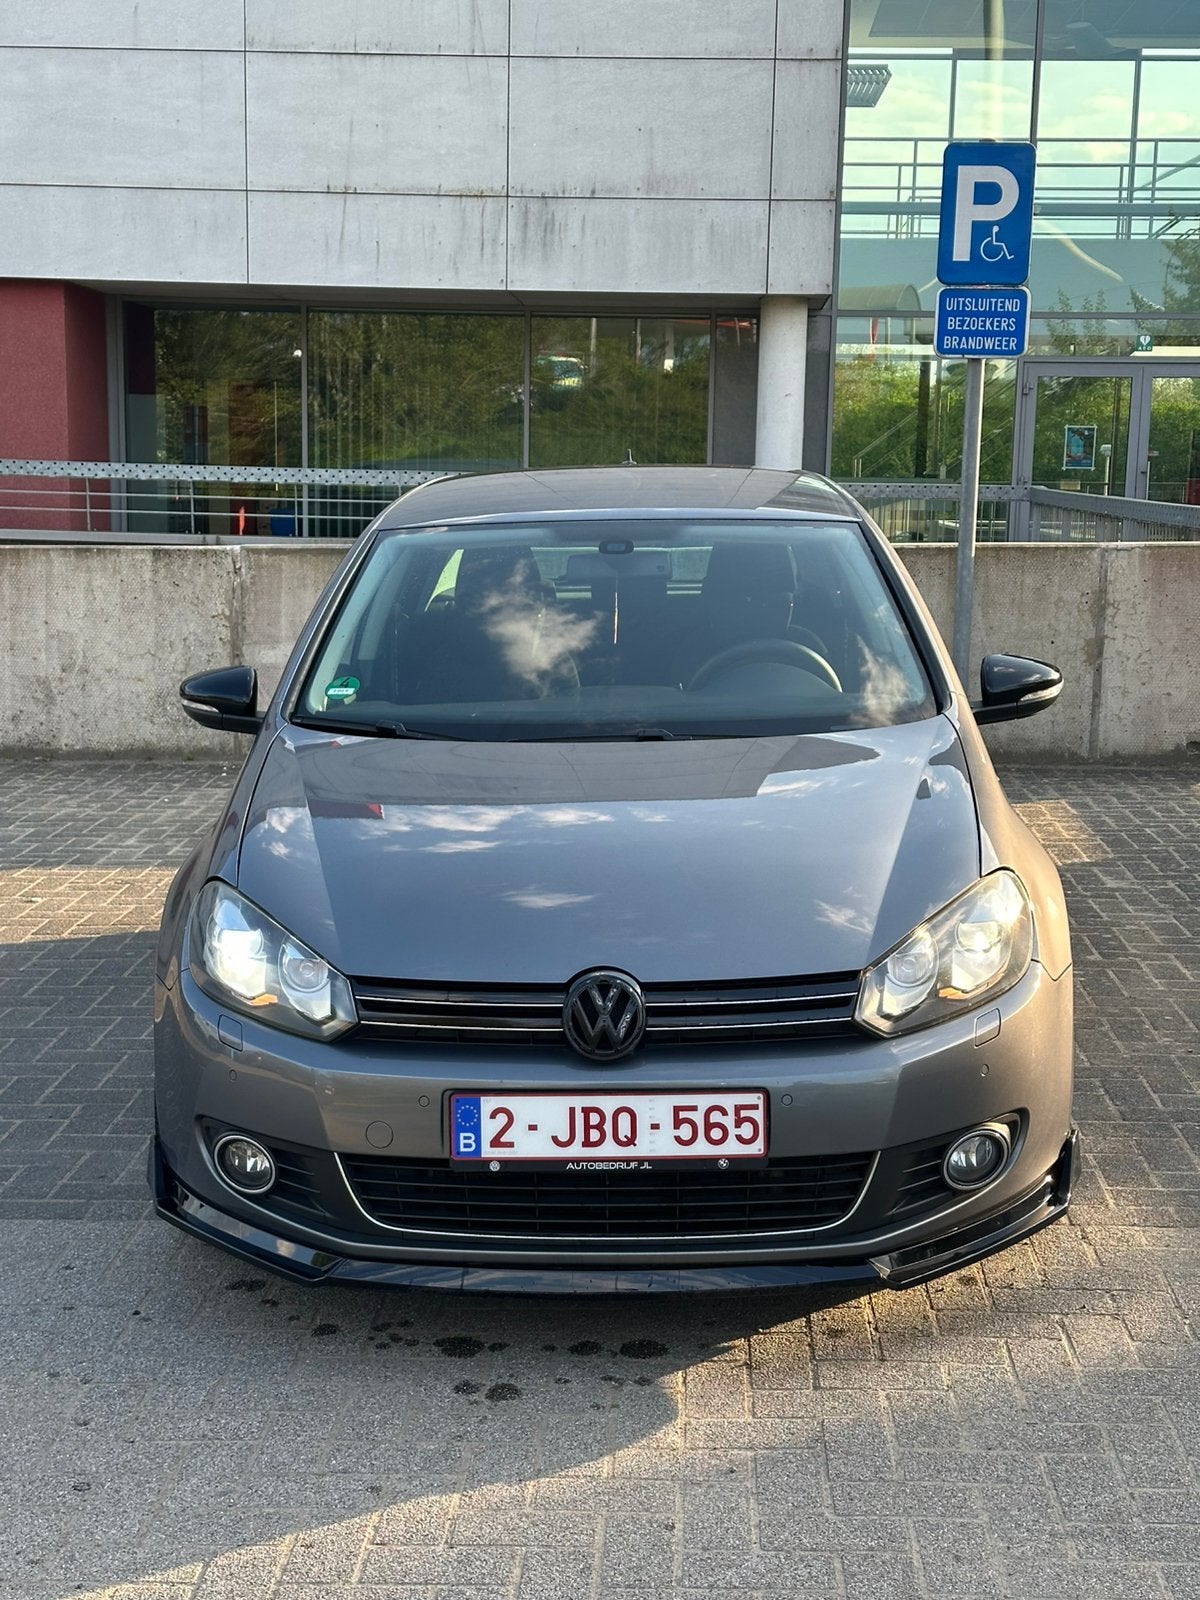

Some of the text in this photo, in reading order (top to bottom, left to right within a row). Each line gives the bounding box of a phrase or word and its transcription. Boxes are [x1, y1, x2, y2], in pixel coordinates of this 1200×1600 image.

[952, 165, 1020, 261] P
[946, 297, 1021, 312] UITSLUITEND
[947, 316, 1016, 331] BEZOEKERS
[943, 335, 1017, 350] BRANDWEER
[459, 1132, 476, 1152] B
